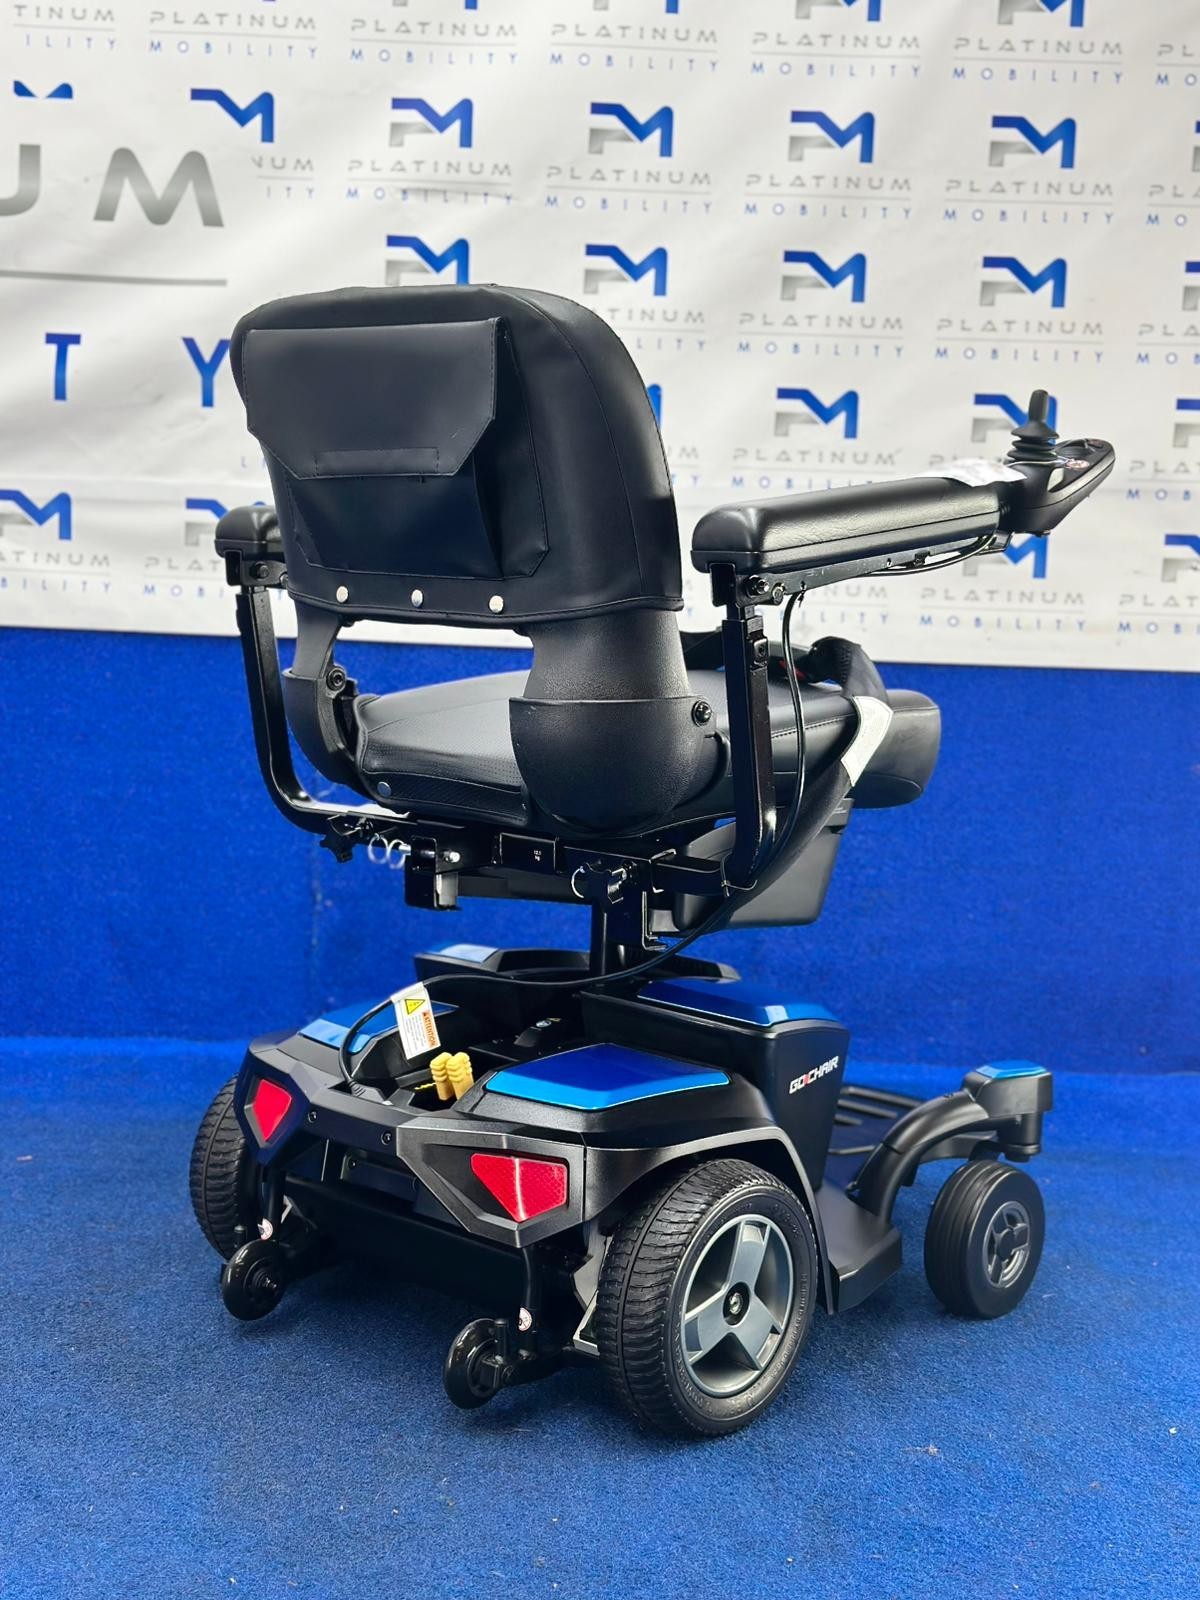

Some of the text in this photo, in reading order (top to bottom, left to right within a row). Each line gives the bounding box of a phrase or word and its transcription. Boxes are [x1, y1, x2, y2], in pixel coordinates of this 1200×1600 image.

[150, 10, 315, 30] PLATINUM
[351, 19, 516, 37] PLATINUM
[552, 23, 717, 44] PLATINUM
[753, 32, 919, 50] PLATINUM
[150, 41, 316, 60] MOBILITY
[955, 37, 1122, 56] PLATINUM
[351, 48, 516, 65] MOBILITY
[550, 52, 717, 72] MOBILITY
[752, 62, 919, 78] MOBILITY
[953, 67, 1122, 84] MOBILITY
[348, 159, 511, 177] PLATINUM
[547, 165, 710, 186] PLATINUM
[746, 174, 910, 192] PLATINUM
[946, 179, 1112, 198] PLATINUM
[346, 187, 512, 205] MOBILITY
[545, 195, 710, 214] MOBILITY
[745, 203, 910, 220] MOBILITY
[944, 209, 1112, 225] MOBILITY
[740, 312, 902, 330] PLATINUM
[938, 317, 1102, 336] PLATINUM
[737, 342, 902, 358] MOBILITY
[935, 347, 1102, 363] MOBILITY
[733, 448, 894, 467] PLATINUM
[922, 587, 1083, 605] PLATINUM
[920, 615, 1084, 631] MOBILITY
